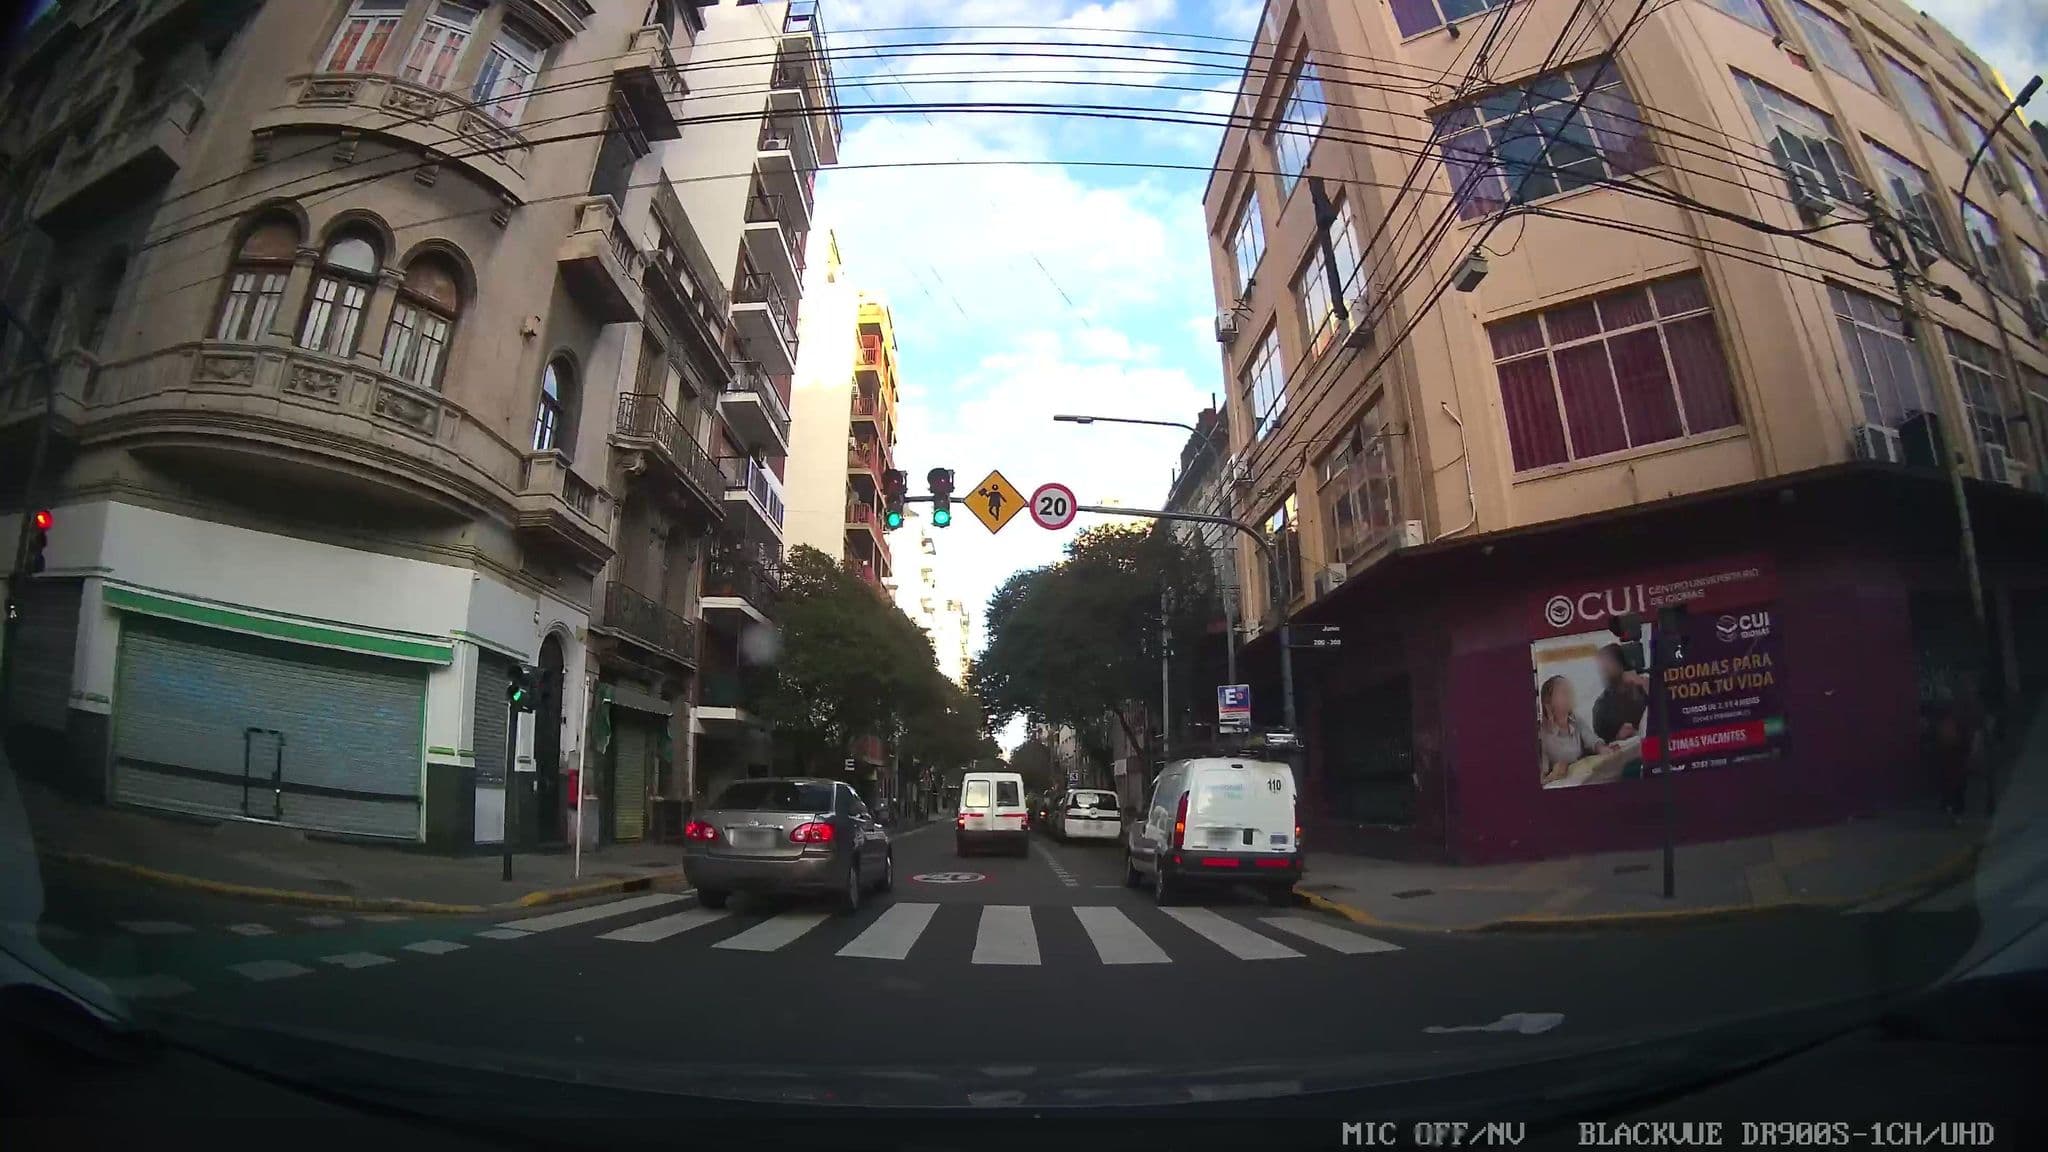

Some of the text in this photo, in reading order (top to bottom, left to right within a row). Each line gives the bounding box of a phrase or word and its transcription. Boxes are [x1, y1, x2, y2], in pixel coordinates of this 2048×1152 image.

[1040, 496, 1067, 517] 20
[1648, 580, 1689, 595] CENTRO
[1578, 584, 1646, 620] CUI
[1738, 611, 1771, 630] CUI
[1663, 652, 1773, 682] IDIOMAS PARA
[1667, 671, 1775, 700] TODA TU VIDA
[1224, 688, 1238, 705] E
[1700, 729, 1747, 746] VACANTES
[1267, 778, 1282, 792] 110
